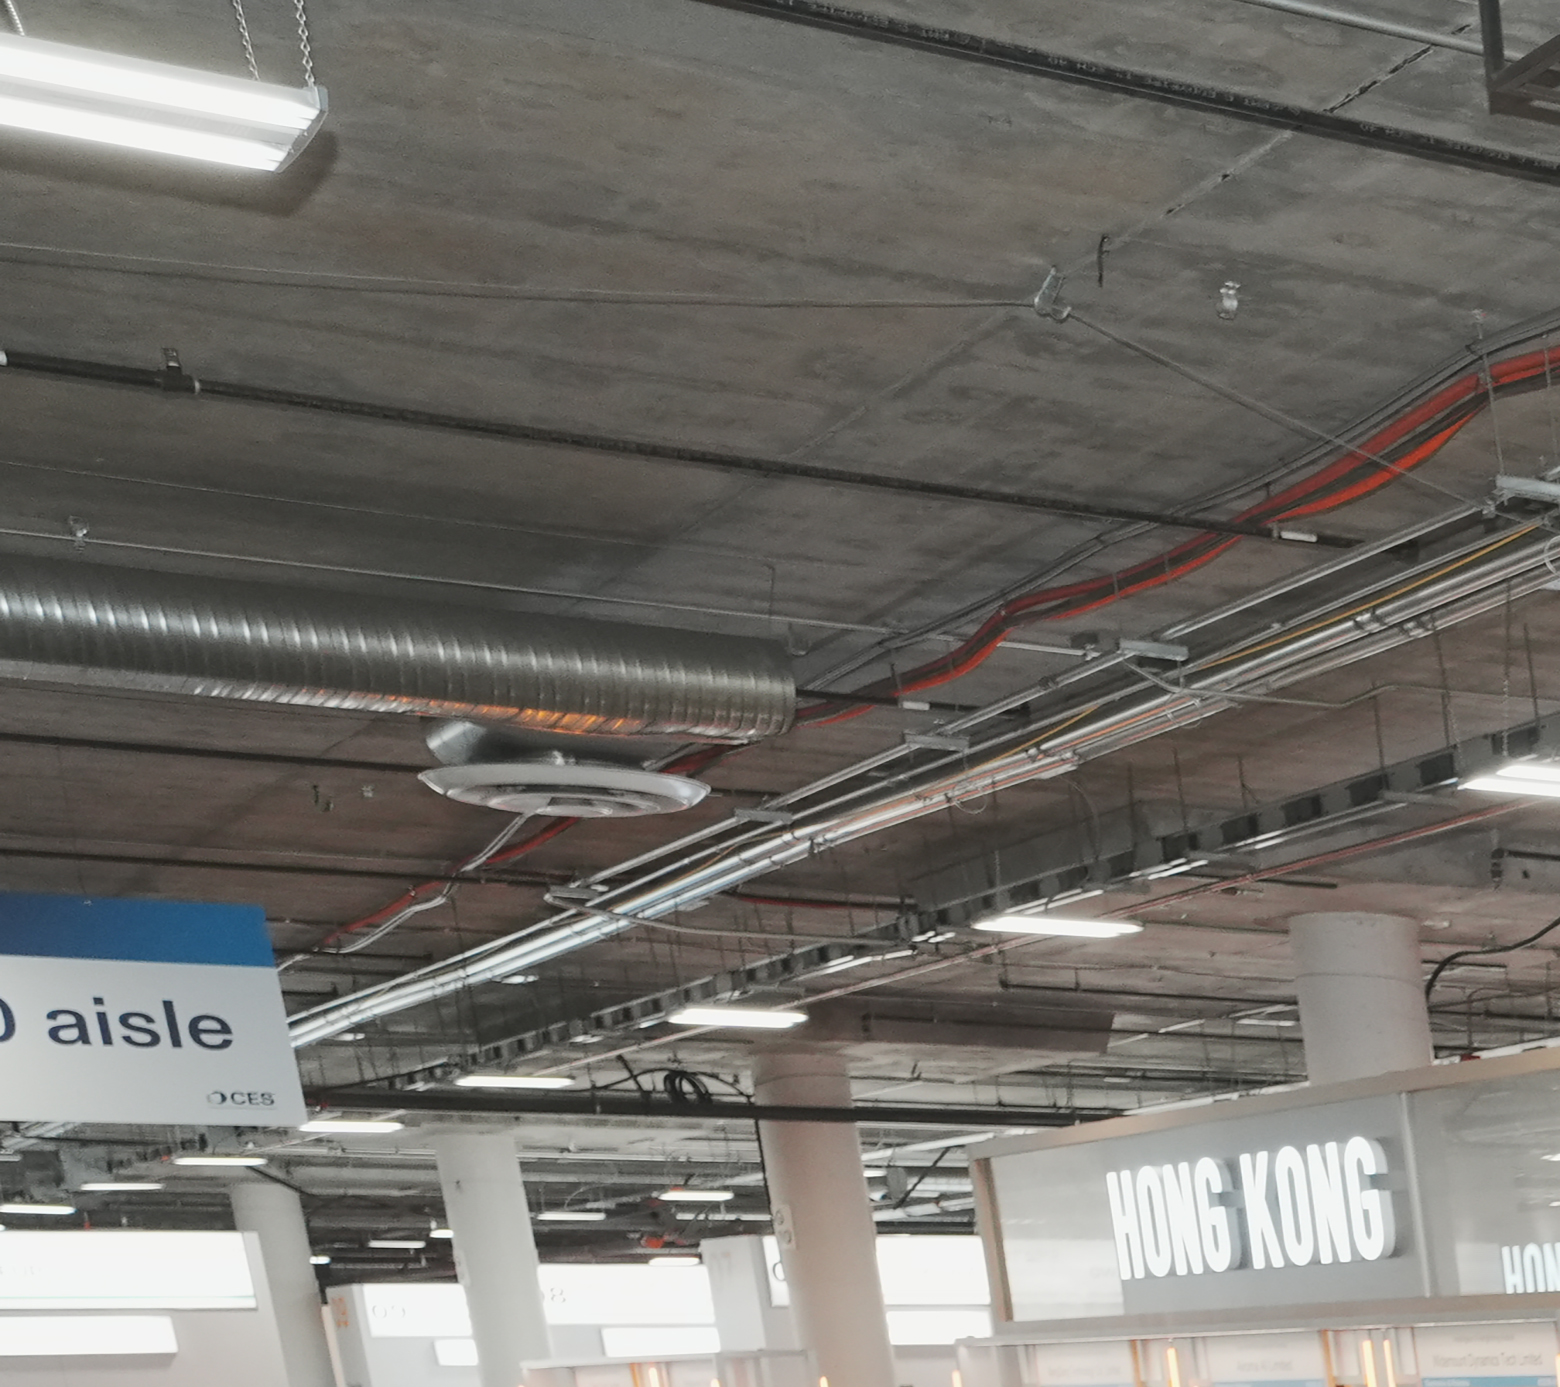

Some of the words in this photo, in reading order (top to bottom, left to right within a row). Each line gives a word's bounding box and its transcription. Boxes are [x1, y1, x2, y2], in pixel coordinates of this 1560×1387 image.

[46, 996, 234, 1051] aisle
[229, 1090, 277, 1107] CES
[1107, 1156, 1236, 1282] HONG
[1240, 1136, 1393, 1271] KONG
